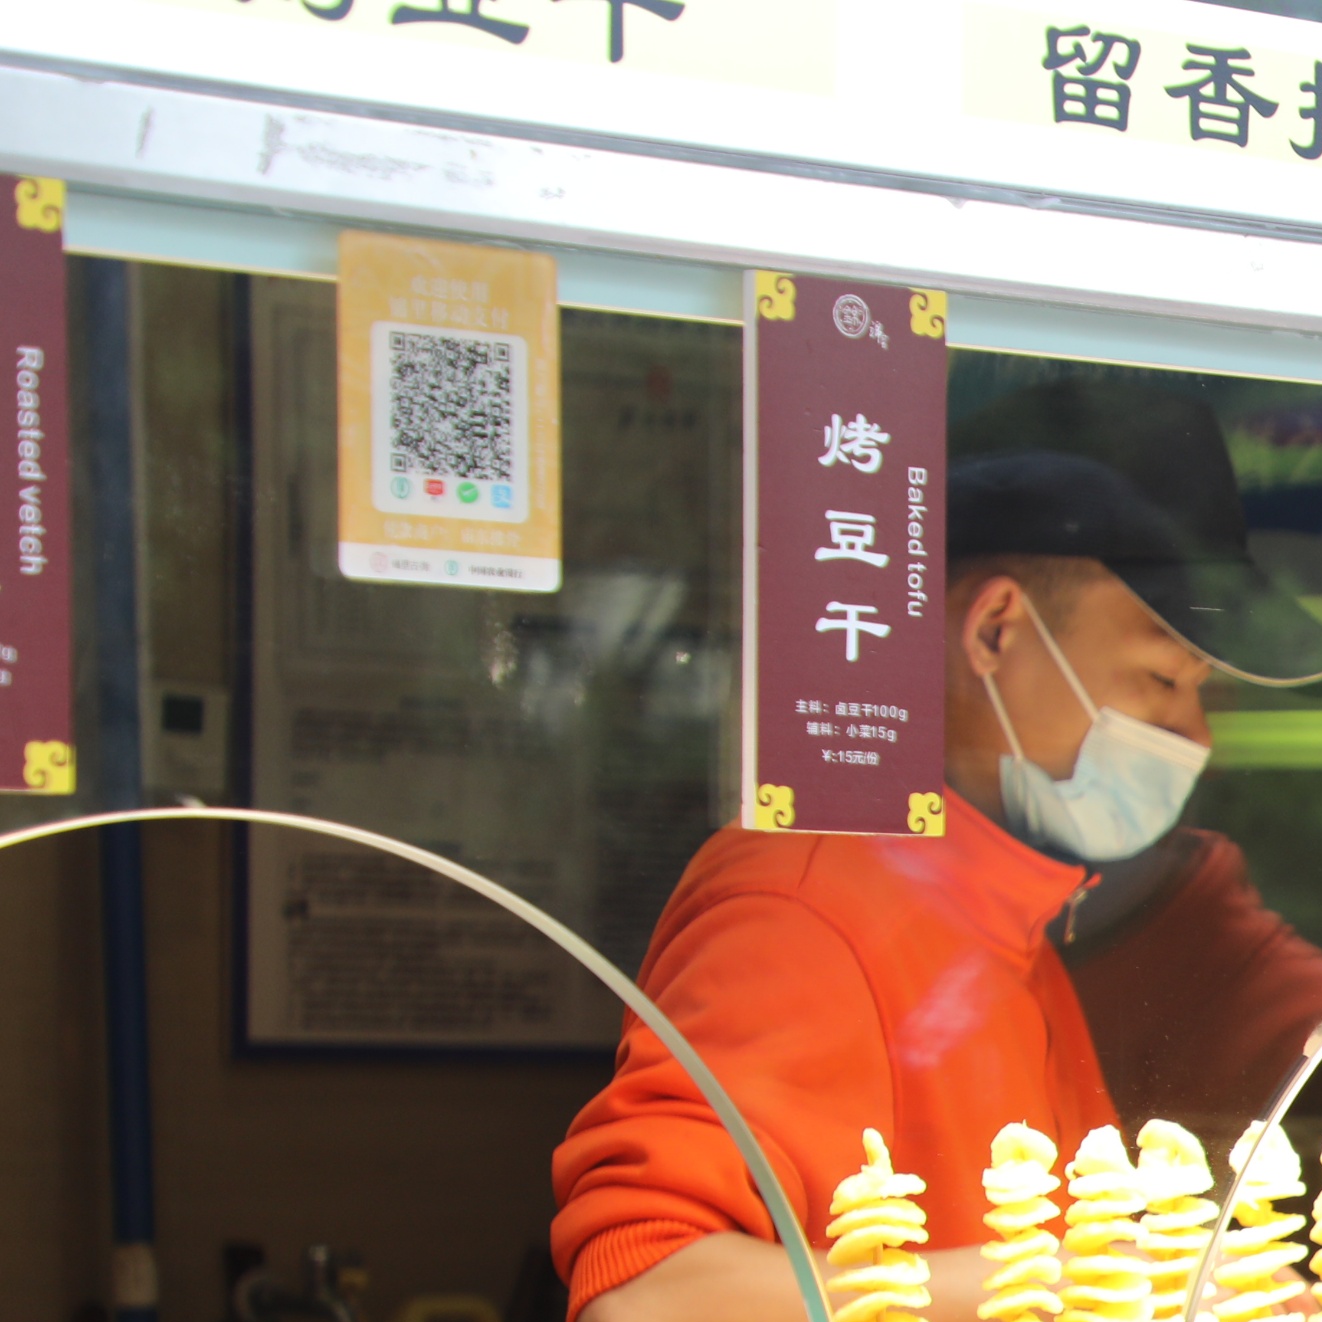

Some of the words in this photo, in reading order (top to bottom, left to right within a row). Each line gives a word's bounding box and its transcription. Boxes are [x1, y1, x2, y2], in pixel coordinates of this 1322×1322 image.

[16, 345, 47, 481] Roasted
[19, 485, 48, 575] vetch
[814, 413, 892, 662] 烤豆干
[907, 466, 928, 556] Baked
[907, 562, 928, 617] tofu
